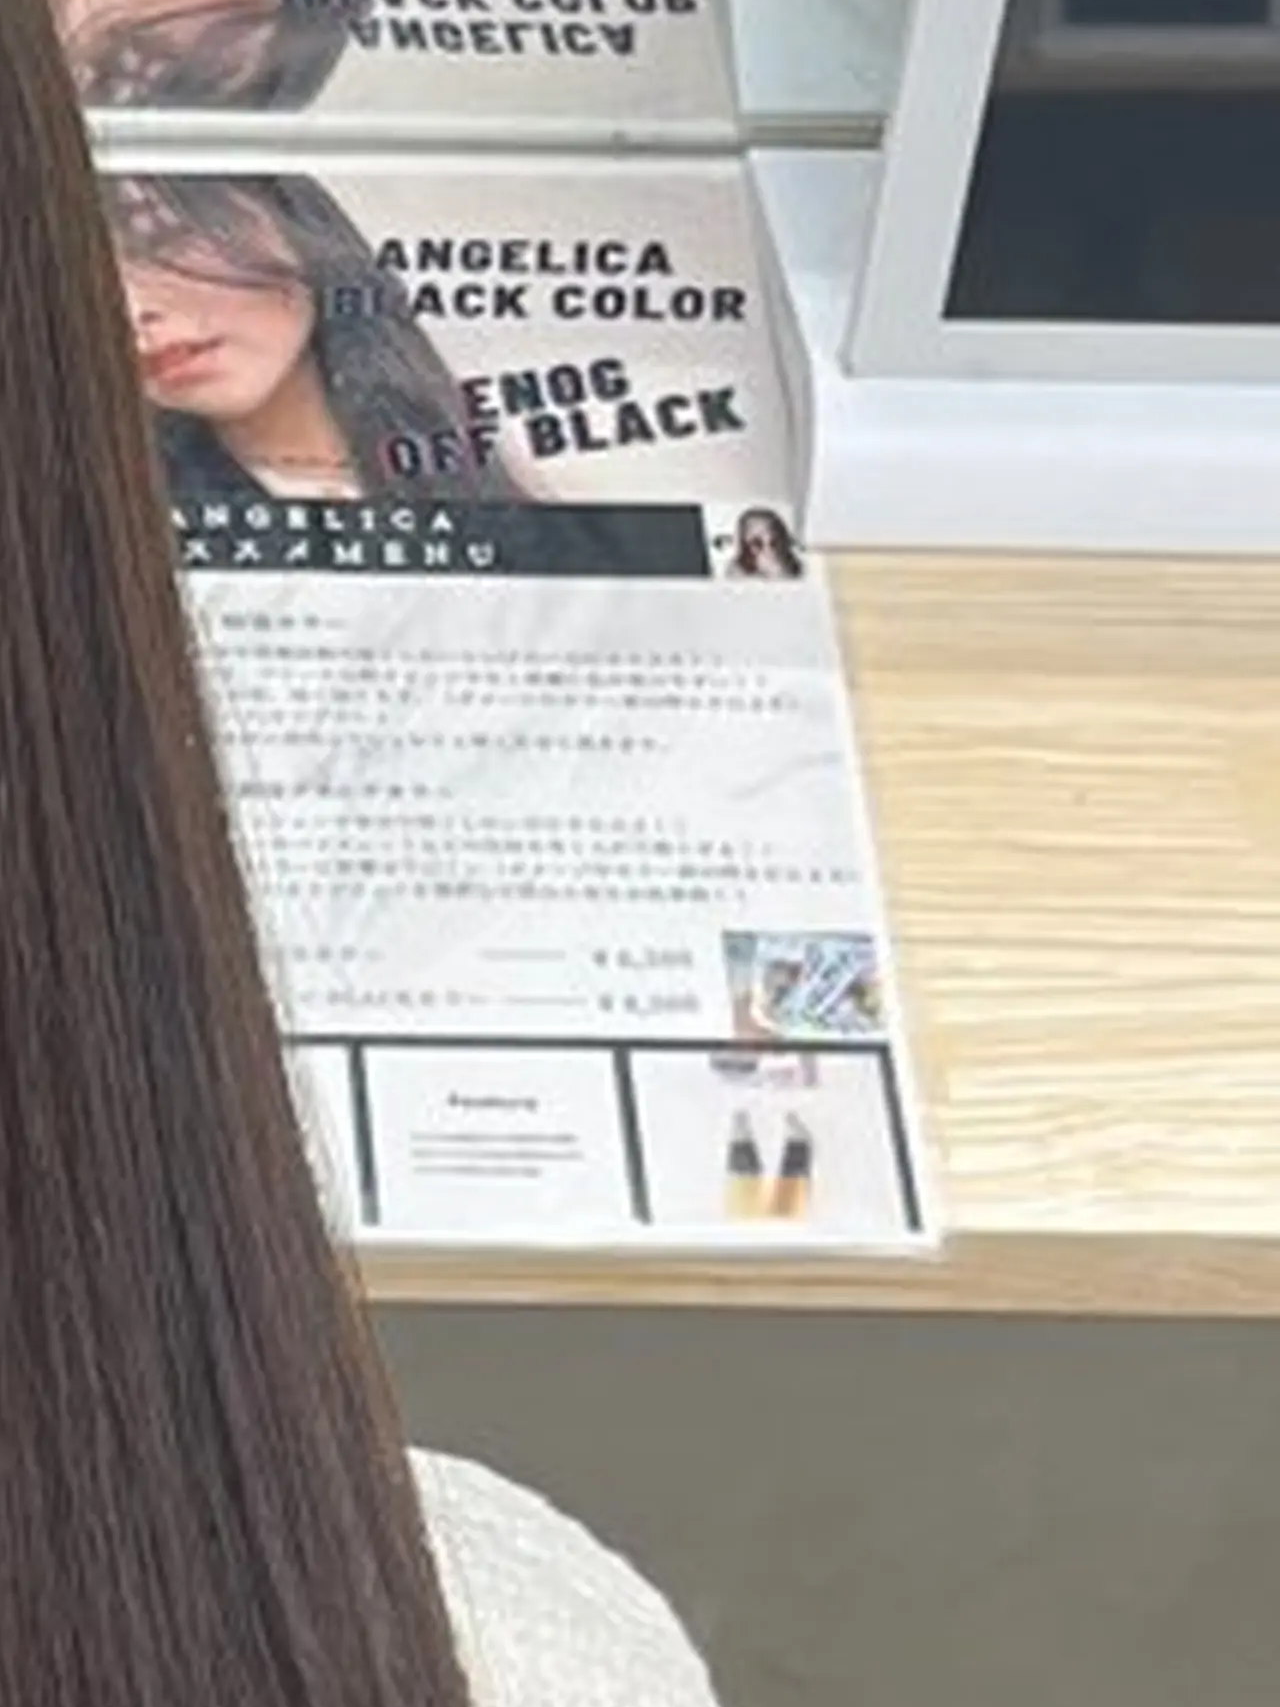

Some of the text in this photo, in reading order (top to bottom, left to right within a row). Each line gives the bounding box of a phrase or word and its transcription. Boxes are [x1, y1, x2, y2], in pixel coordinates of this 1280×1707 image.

[376, 238, 673, 277] ANGELICA
[329, 281, 747, 322] BLACK COLOR
[461, 358, 631, 421] ENOG
[384, 387, 746, 481] OFF BLACK
